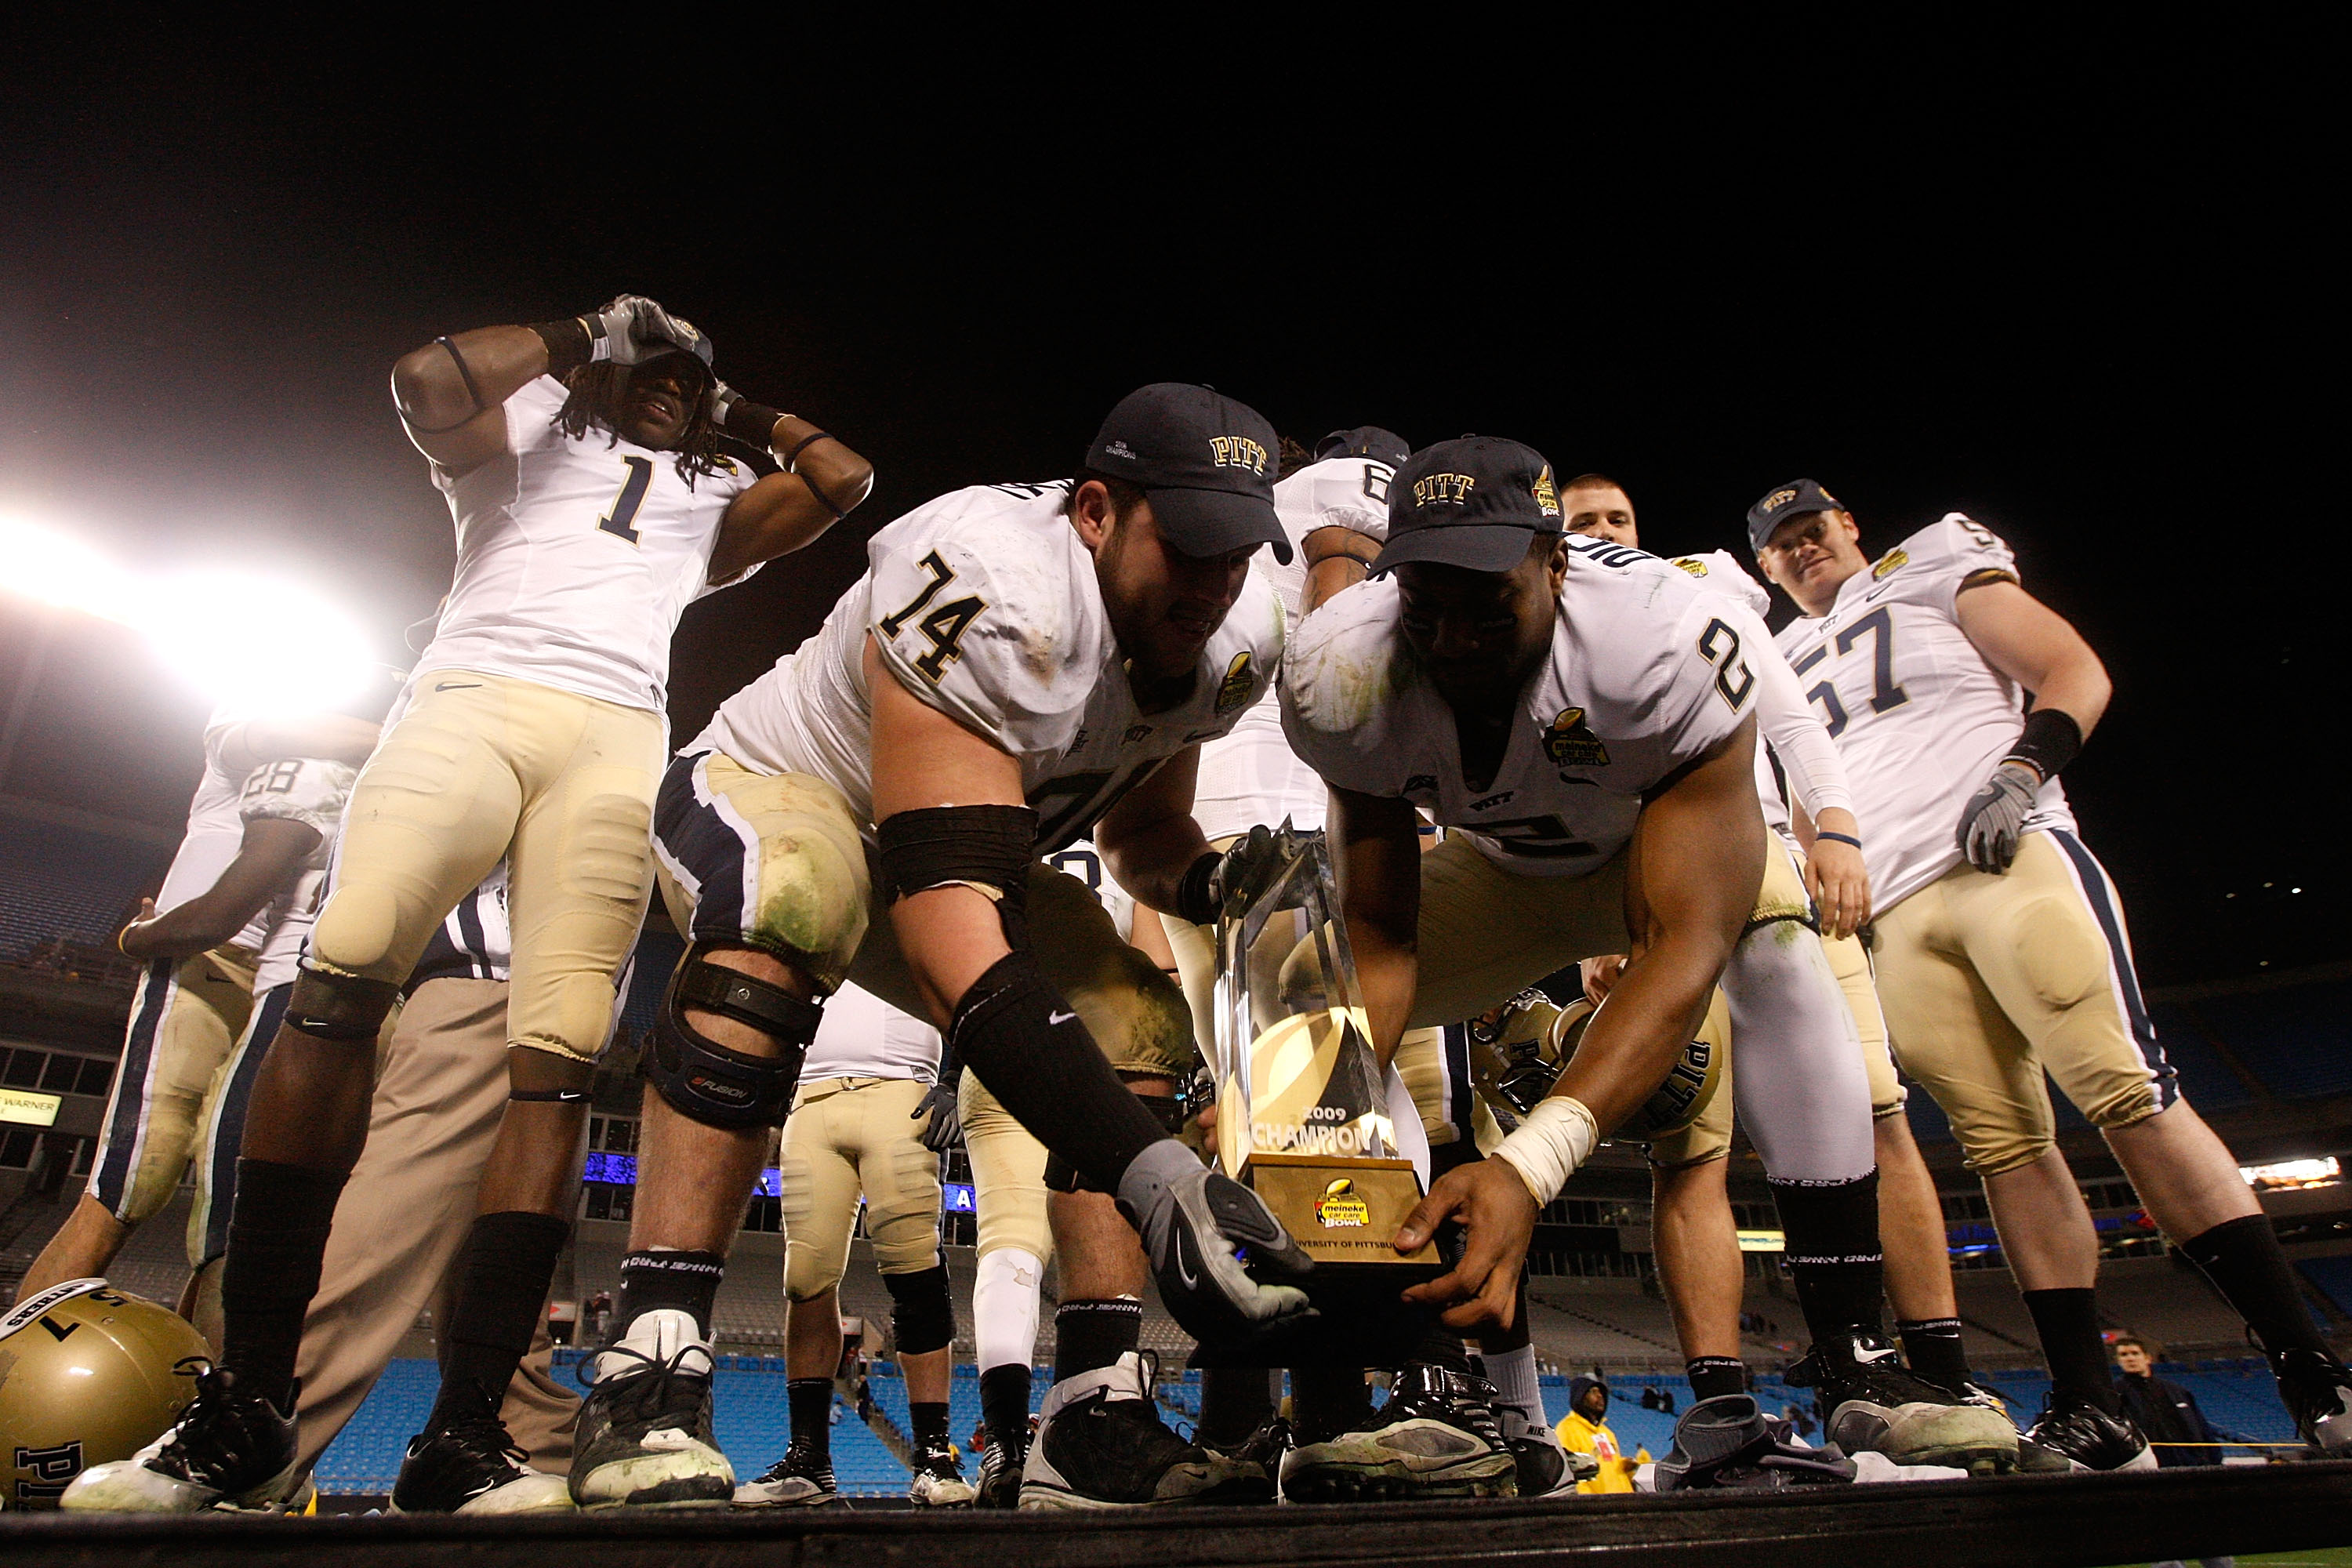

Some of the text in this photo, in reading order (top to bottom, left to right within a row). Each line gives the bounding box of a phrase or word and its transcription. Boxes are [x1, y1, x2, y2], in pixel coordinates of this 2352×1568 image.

[1209, 436, 1268, 477] PITT
[595, 454, 656, 550] 1
[1414, 472, 1475, 509] PITT
[1762, 489, 1797, 514] PITT
[877, 547, 990, 684] 74
[1696, 616, 1756, 714] 2
[1793, 603, 1911, 740] 57
[244, 759, 305, 799] 28
[700, 1080, 749, 1098] FUSION
[4, 1098, 55, 1111] WARNER
[1303, 1106, 1347, 1121] 2009
[956, 1189, 971, 1208] A
[1323, 1218, 1364, 1229] BOWL
[1295, 1240, 1338, 1248] IVERSITY
[1355, 1240, 1396, 1249] PITTSBU
[1526, 1425, 1546, 1437] NIKE
